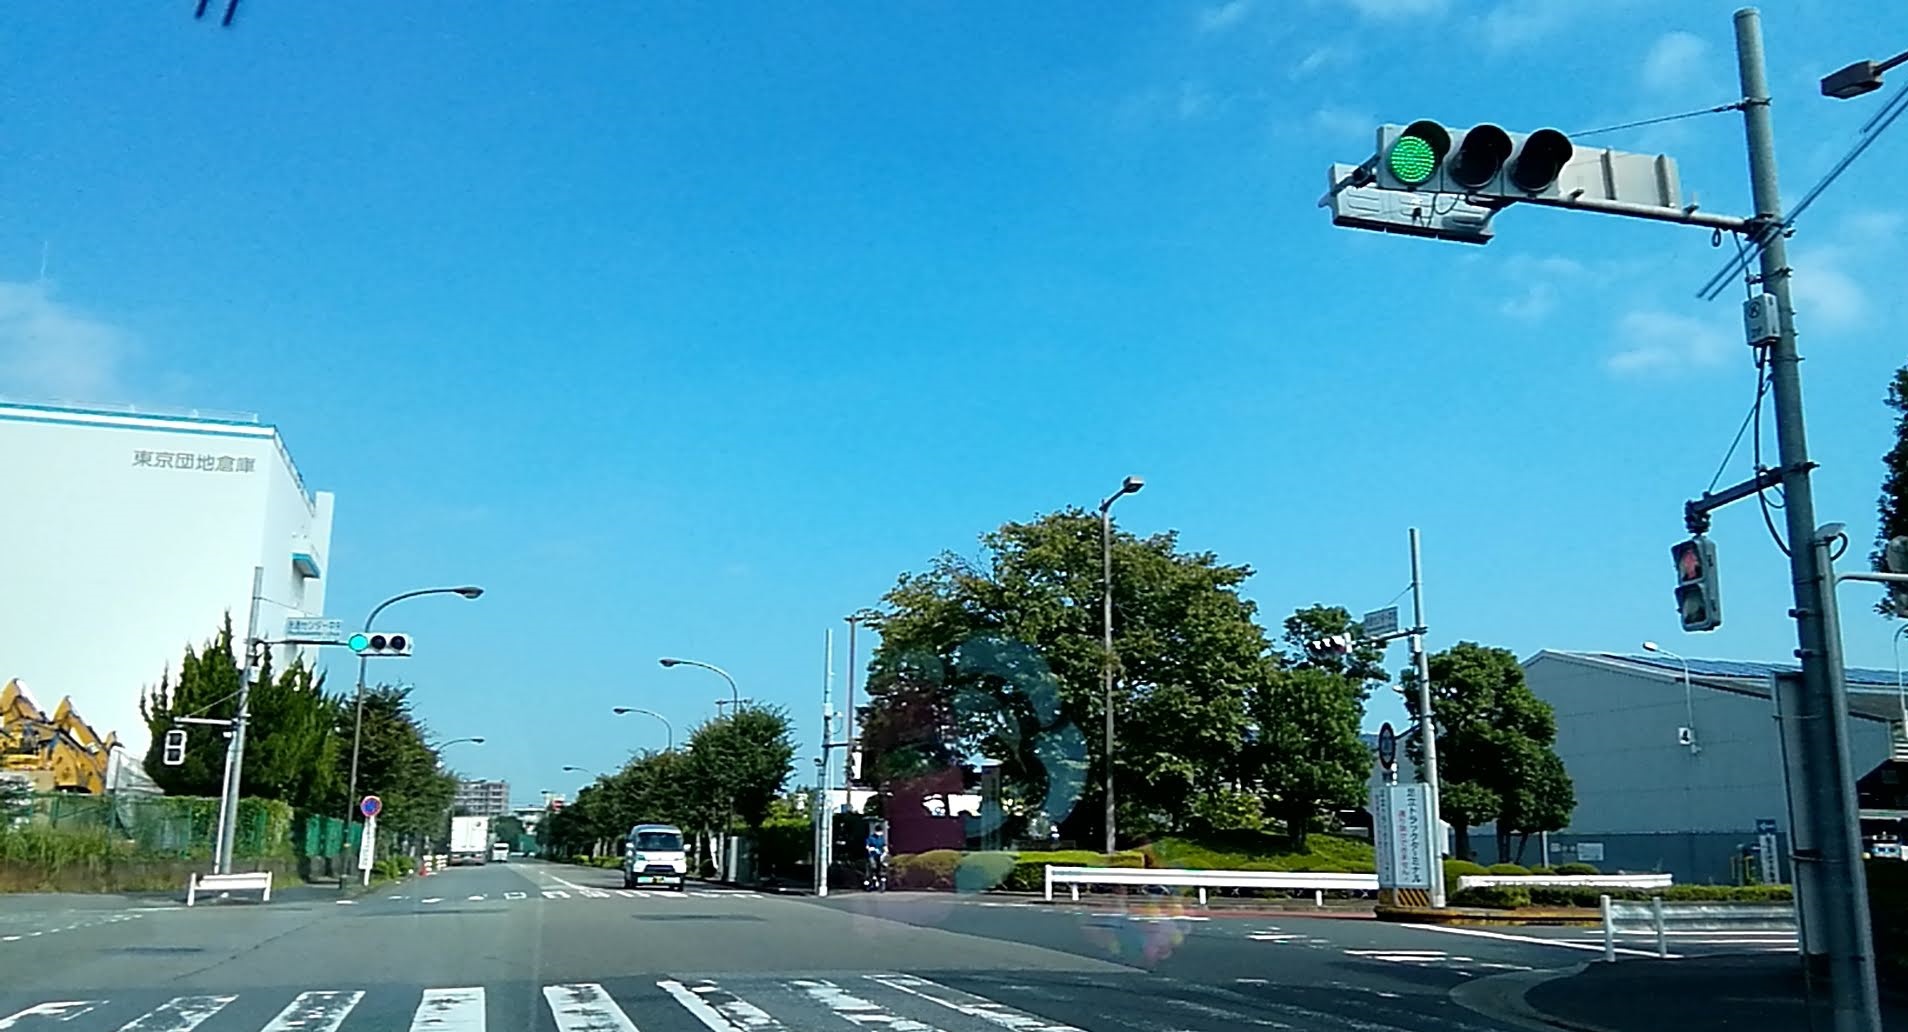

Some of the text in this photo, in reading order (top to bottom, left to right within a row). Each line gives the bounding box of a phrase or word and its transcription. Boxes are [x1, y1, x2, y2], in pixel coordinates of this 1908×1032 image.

[132, 449, 256, 473] 東京団地倉庫
